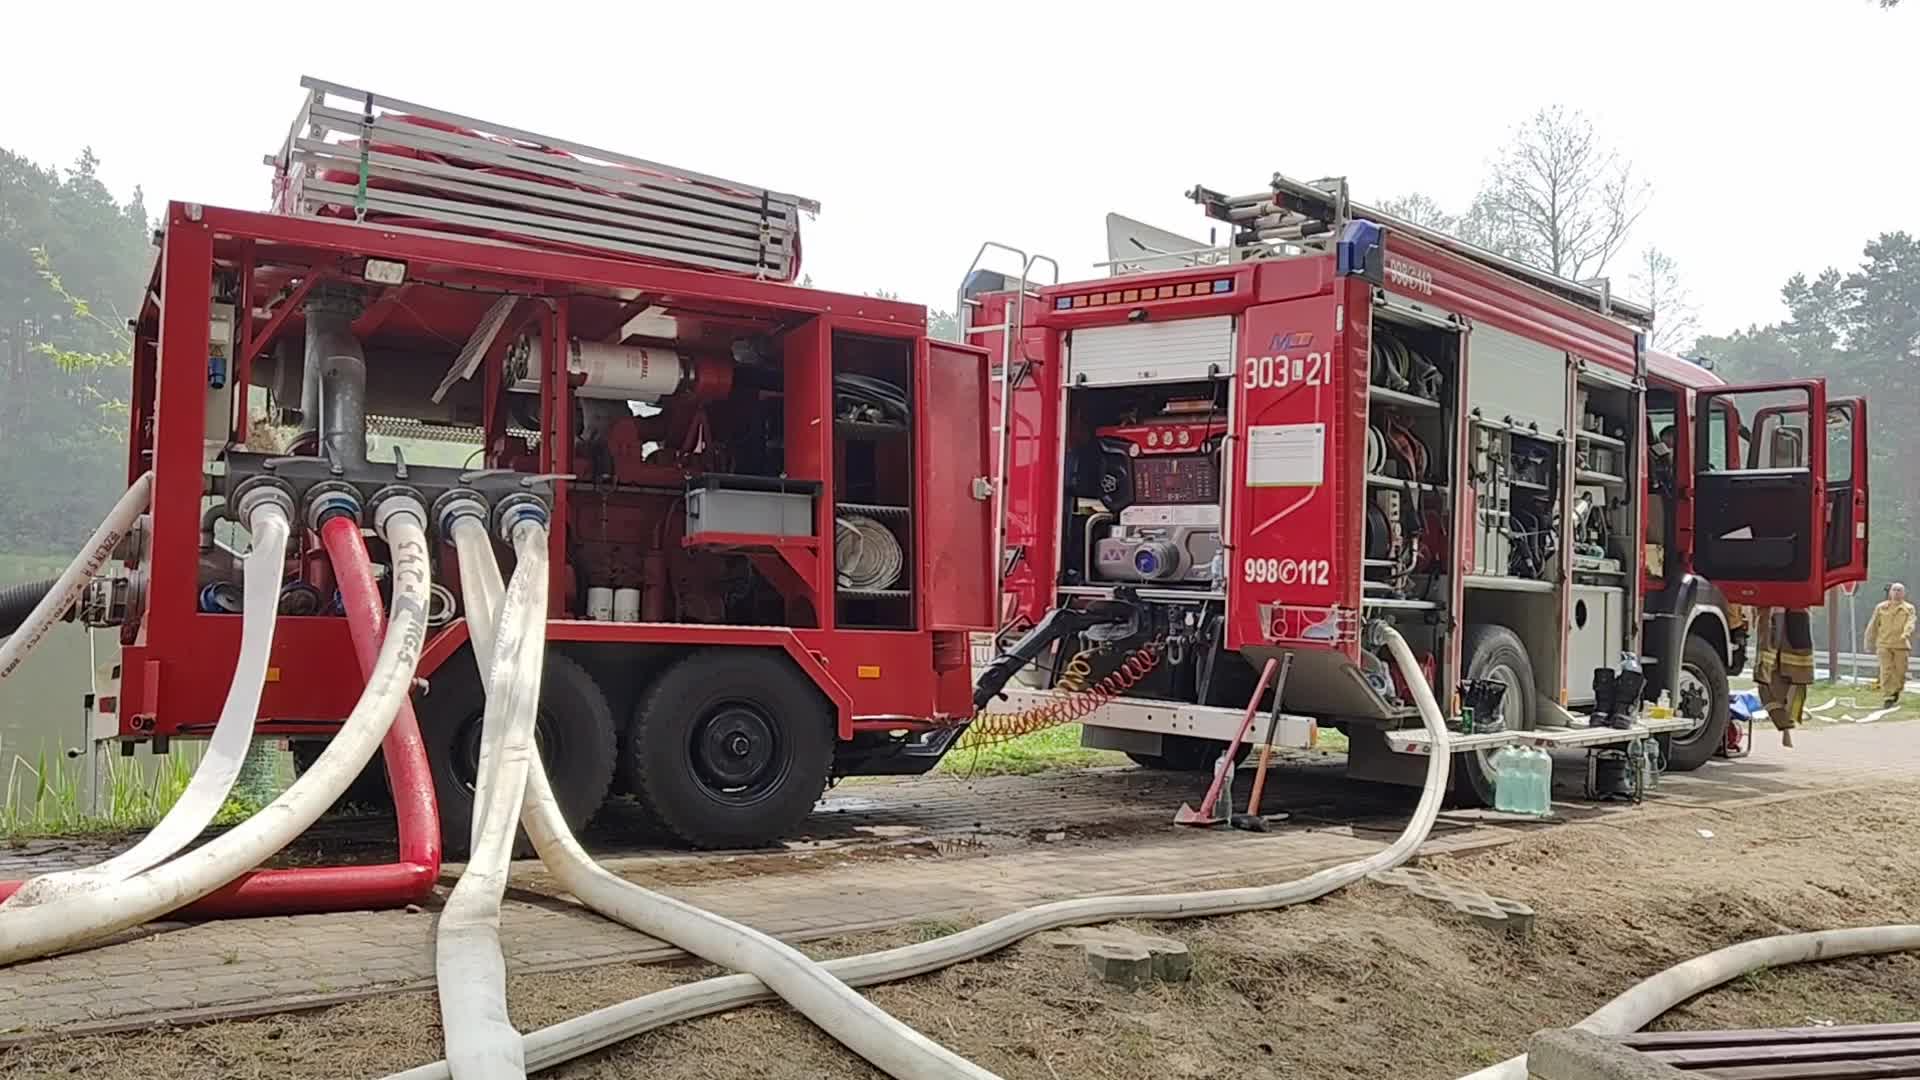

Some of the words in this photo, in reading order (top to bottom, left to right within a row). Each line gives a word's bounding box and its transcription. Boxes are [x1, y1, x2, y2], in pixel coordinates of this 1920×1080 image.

[1390, 259, 1408, 288] 998
[1416, 267, 1433, 296] 112
[1243, 354, 1290, 389] 303
[1306, 351, 1331, 386] 21
[1244, 557, 1279, 584] 998
[1298, 559, 1330, 586] 112
